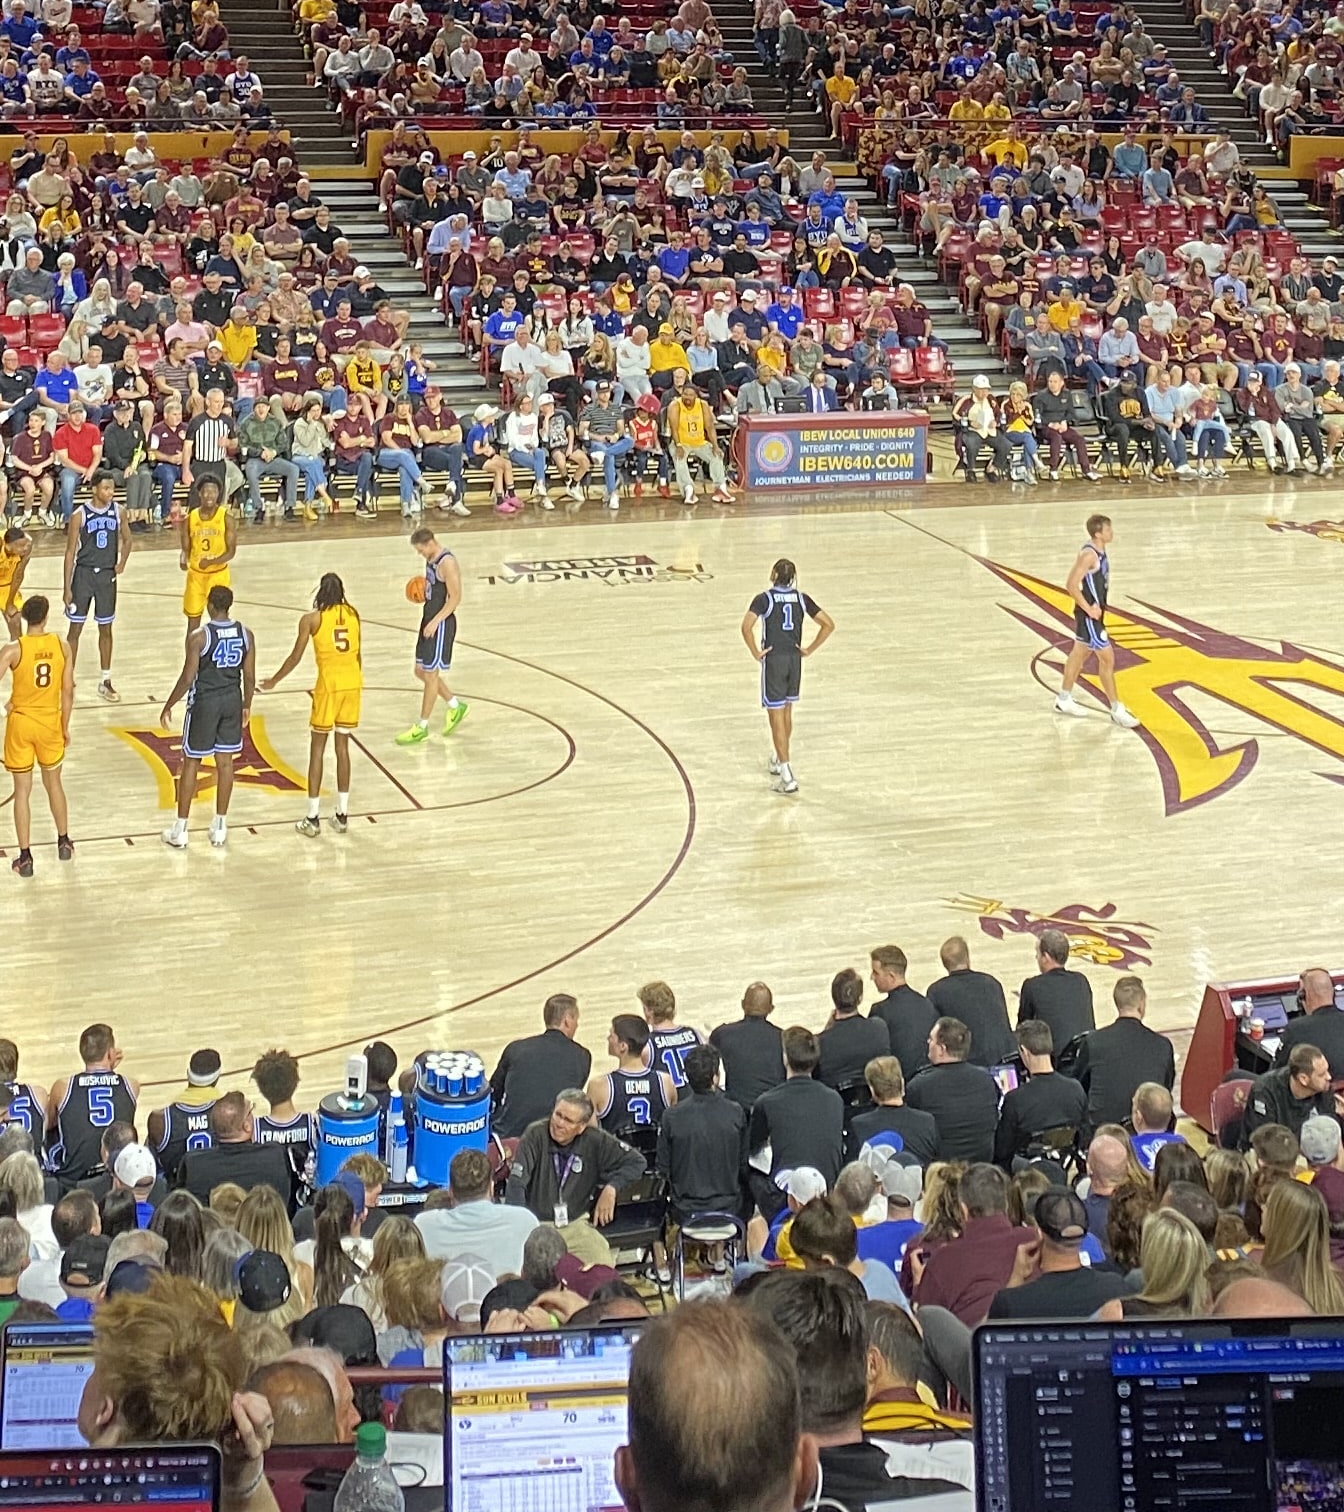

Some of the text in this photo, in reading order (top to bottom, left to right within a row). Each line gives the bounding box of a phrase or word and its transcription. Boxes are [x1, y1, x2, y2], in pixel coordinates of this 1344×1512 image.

[688, 422, 697, 432] 13
[800, 428, 915, 441] IBEW LOCAL UNION 640
[800, 442, 913, 453] INTEGRITY PRIDE DIGNITY
[800, 453, 914, 472] IBEW640.COM
[755, 472, 913, 486] JOURNEYMAN ELECTRICIANS NEEDED!
[201, 539, 210, 552] 3
[783, 603, 794, 630] 1
[333, 629, 350, 653] 5
[212, 639, 243, 668] 45
[35, 662, 51, 688] 8
[625, 1080, 650, 1094] DEMIN
[88, 1087, 114, 1127] 5
[627, 1097, 651, 1124] 3
[188, 1117, 209, 1131] MAG
[424, 1118, 486, 1135] POWERADE
[260, 1128, 308, 1144] CRAWFORD
[326, 1133, 375, 1146] POWERADE
[563, 1413, 577, 1423] 70
